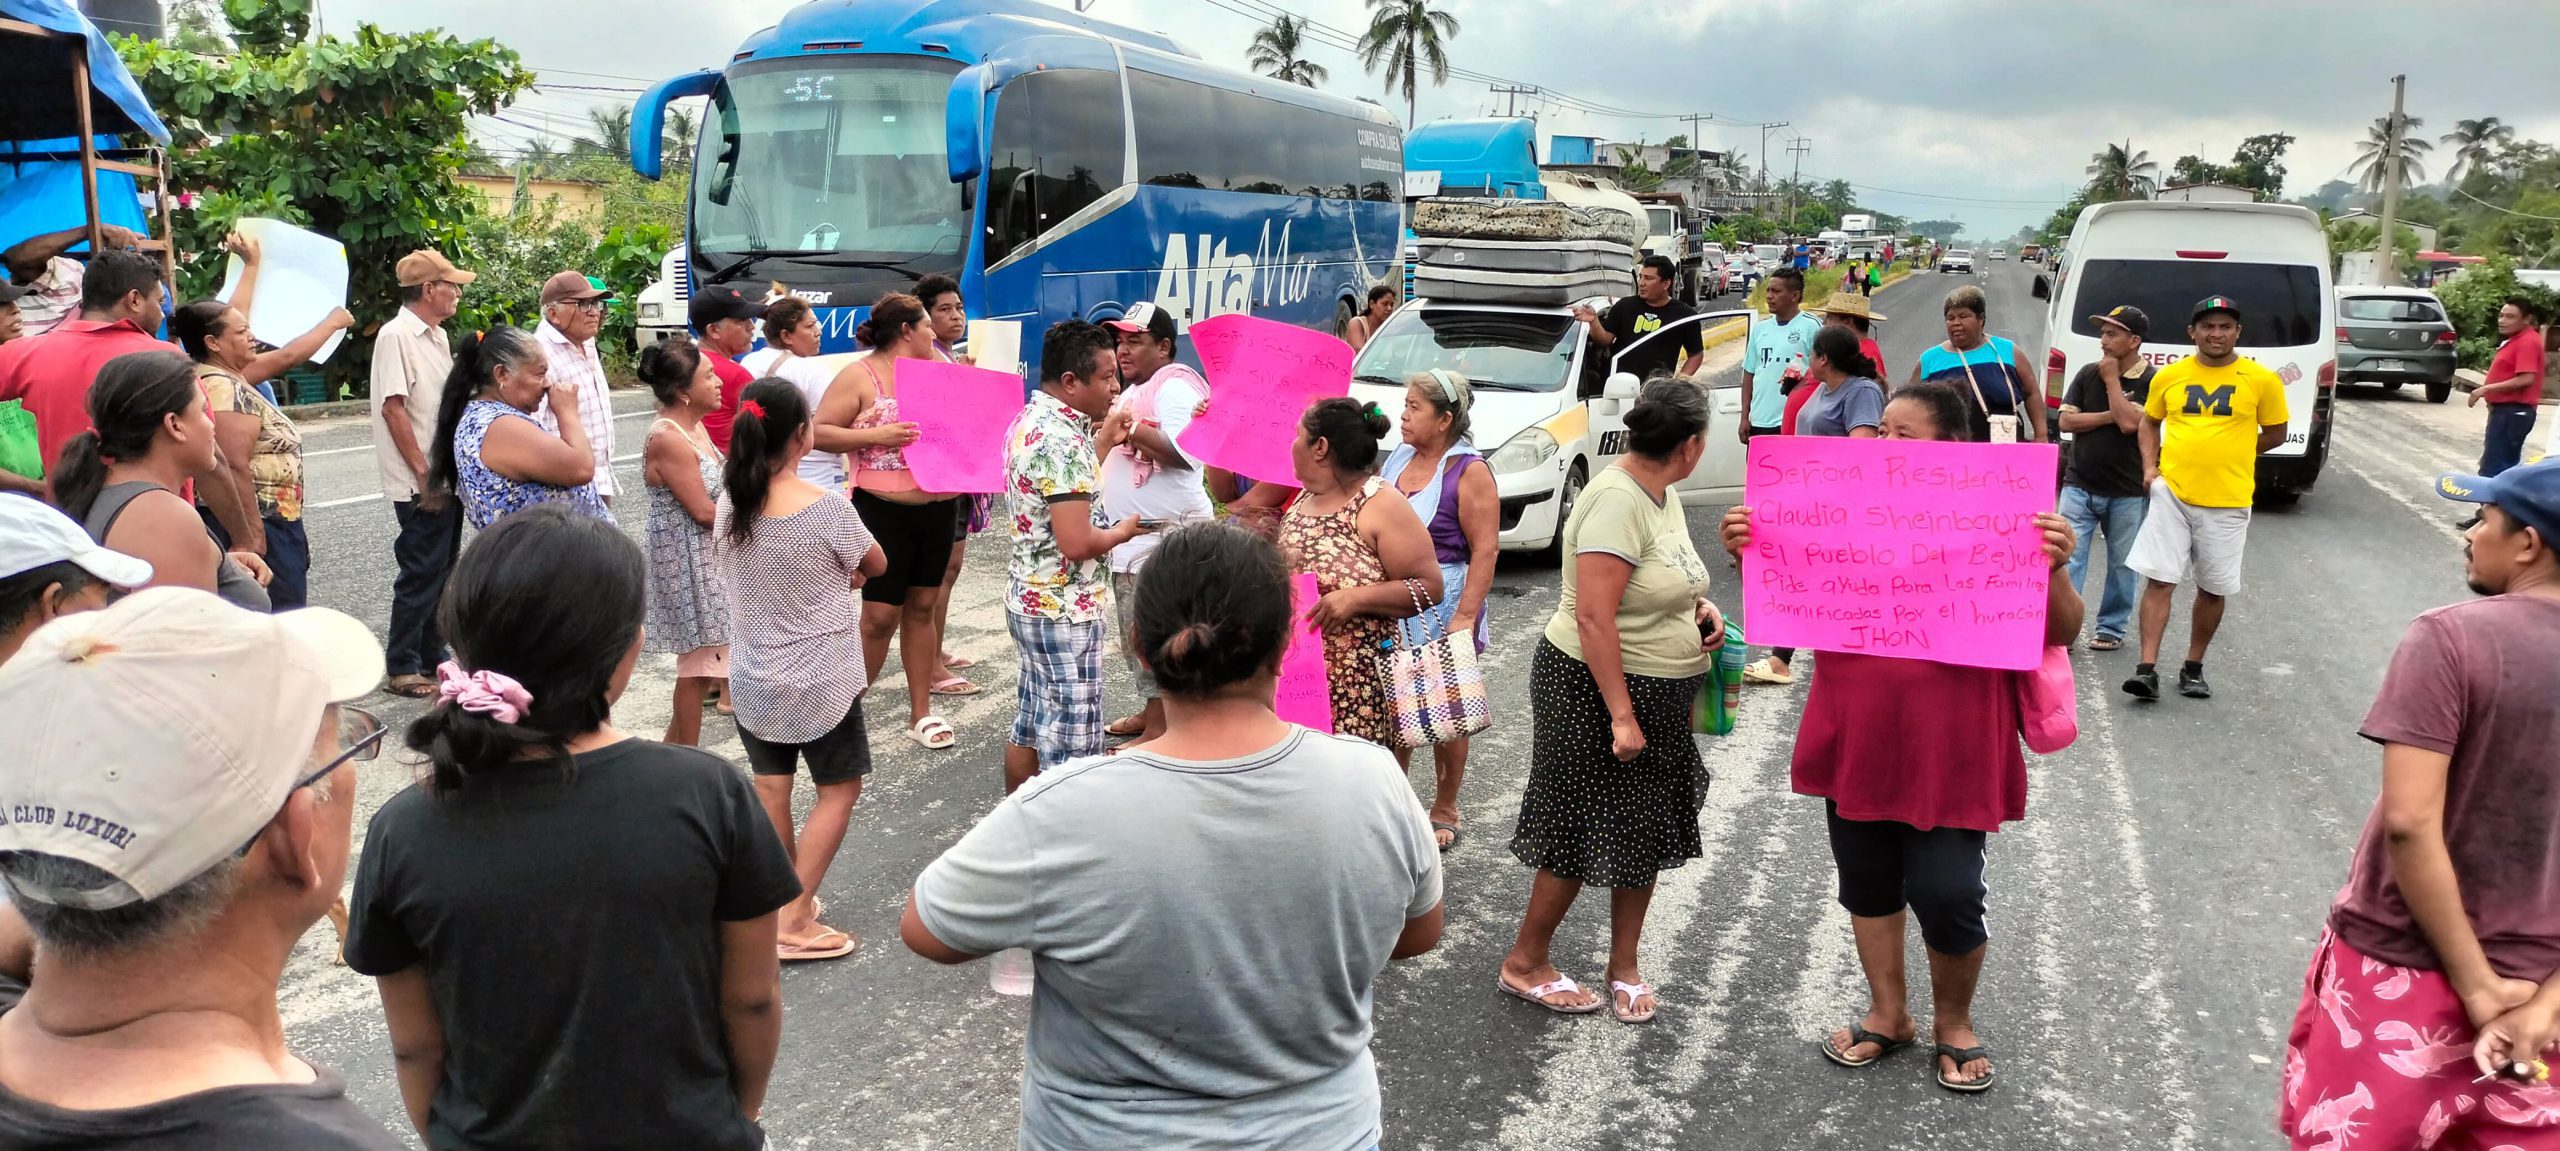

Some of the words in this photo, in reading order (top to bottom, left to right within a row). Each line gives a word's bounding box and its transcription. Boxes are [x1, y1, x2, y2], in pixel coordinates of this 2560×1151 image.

[1357, 129, 1380, 148] COMPRA
[1153, 233, 1252, 336] Alta
[1248, 218, 1318, 307] Mar
[2182, 384, 2237, 417] M
[1757, 453, 1864, 488] Señora
[1885, 455, 2033, 494] Presidenta
[1758, 498, 1848, 528] Claudia
[1759, 541, 1788, 566] el
[1911, 542, 1947, 566] Del
[1761, 567, 1809, 594] Pide
[1938, 602, 1956, 623] el
[1840, 624, 1931, 650] JHON
[14, 804, 56, 825] CLUB
